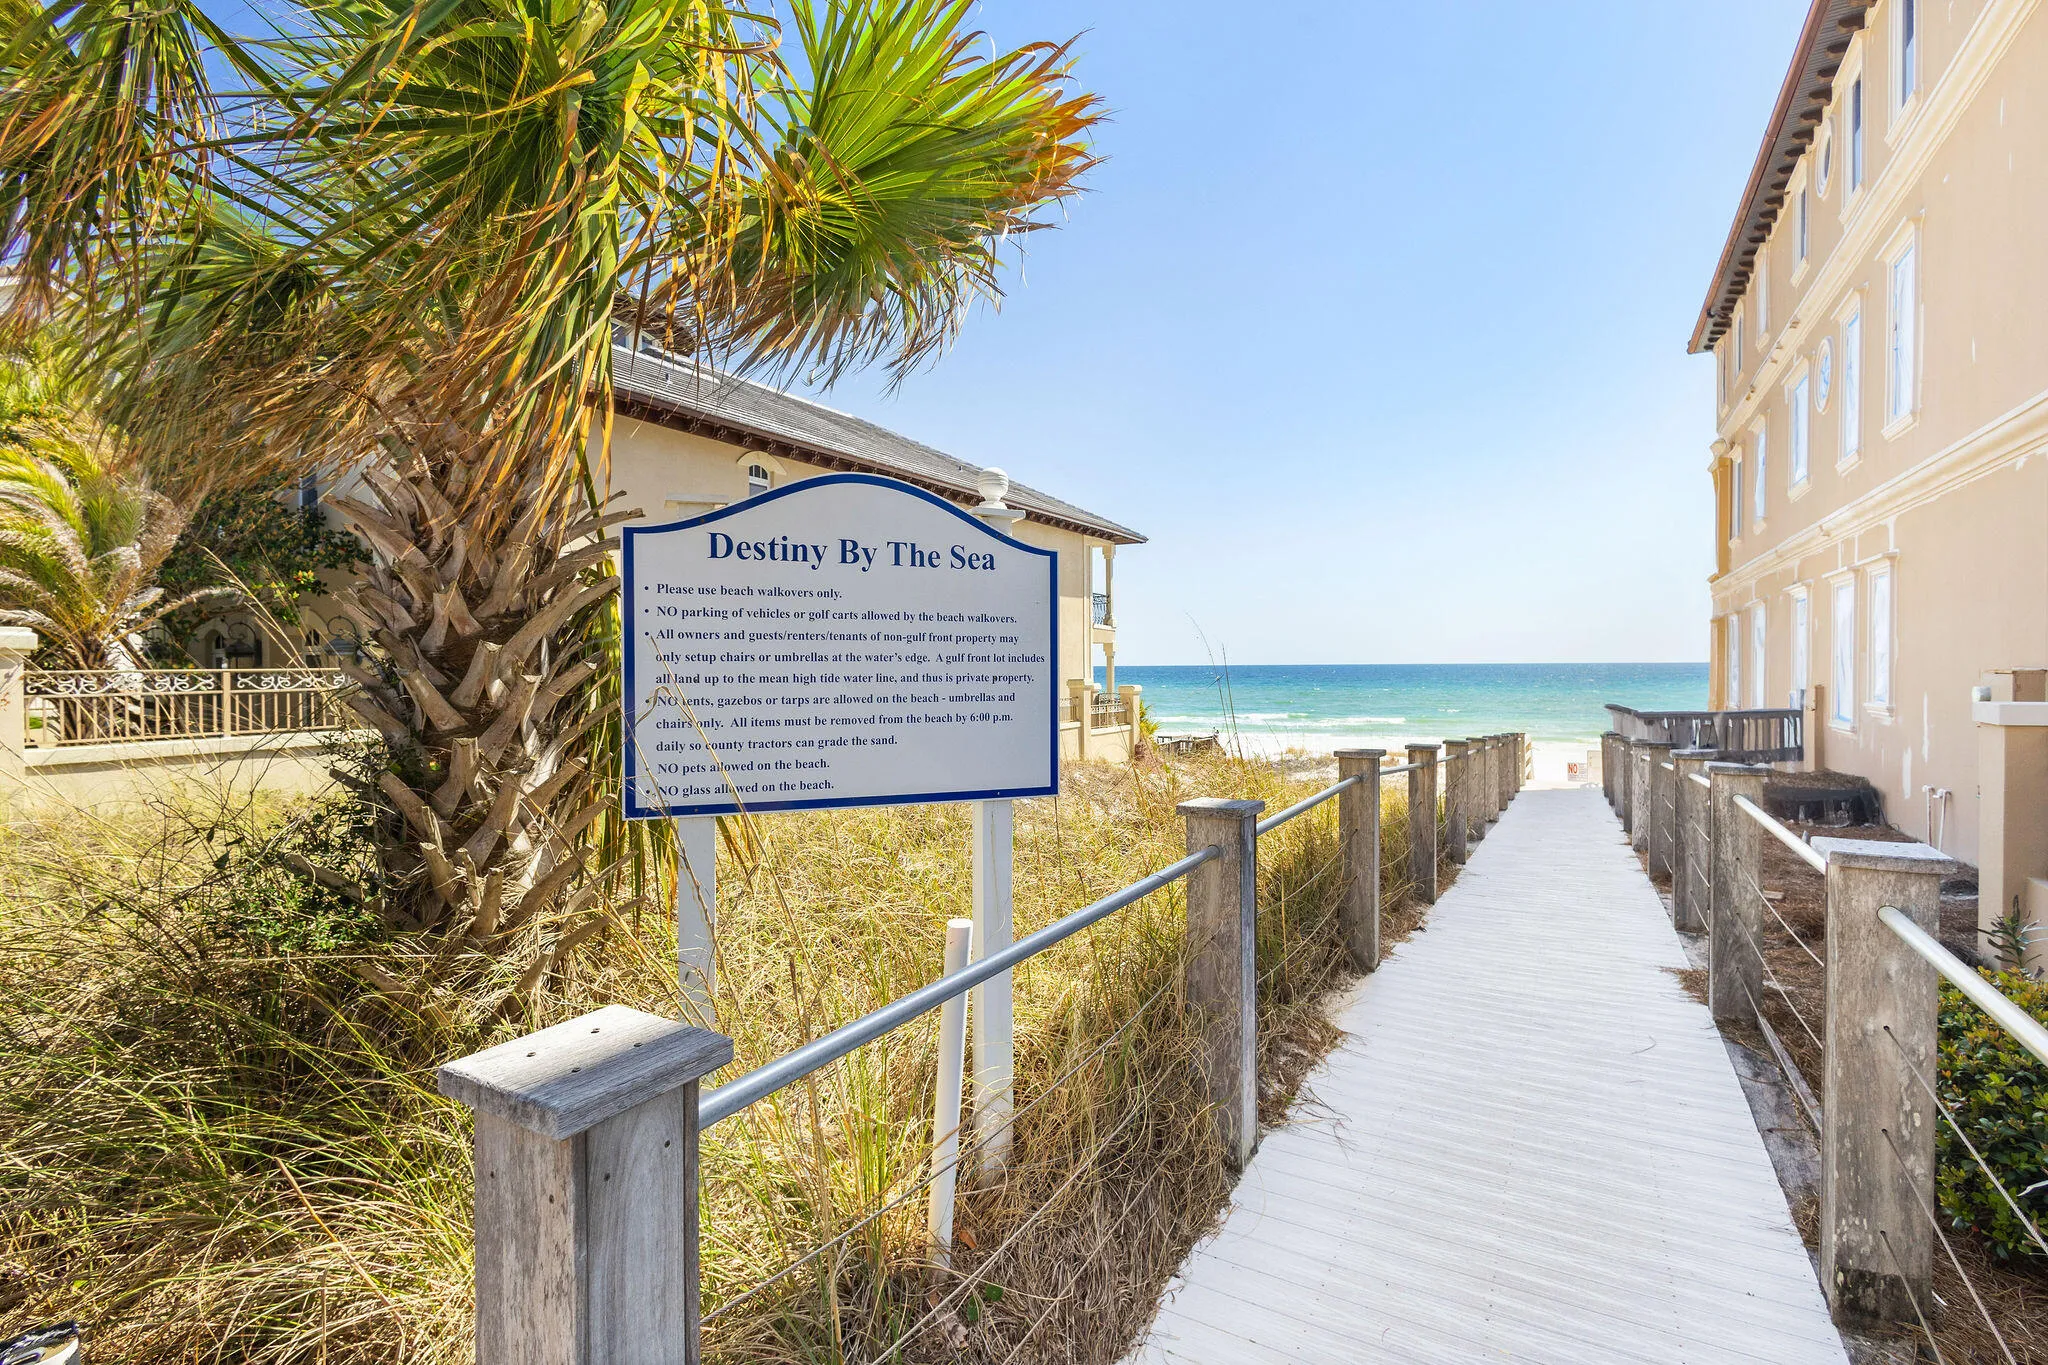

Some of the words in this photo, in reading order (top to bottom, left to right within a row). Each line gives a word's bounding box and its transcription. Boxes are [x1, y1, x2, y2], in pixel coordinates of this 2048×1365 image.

[707, 532, 828, 570] Destiny
[838, 539, 877, 572] By
[887, 541, 941, 568] The
[950, 545, 995, 570] Sea
[657, 584, 694, 594] Please
[721, 585, 753, 596] beach
[758, 587, 813, 597] walkovers
[817, 589, 842, 600] only.
[657, 606, 677, 616] NO
[682, 607, 728, 619] parking
[732, 608, 744, 617] of
[747, 608, 790, 619] vehicles
[794, 611, 805, 619] or
[809, 610, 830, 620] golf
[862, 611, 900, 620] allowed
[904, 612, 915, 623] by
[919, 612, 934, 621] the
[937, 613, 964, 622] beach
[968, 614, 1017, 623] walkovers.
[656, 629, 674, 639] All
[724, 630, 745, 639] and
[749, 630, 867, 642] guests/renters/tenants
[871, 632, 881, 641] of
[884, 633, 926, 644] non-gulf
[929, 633, 952, 642] front
[955, 634, 996, 645] property
[1000, 636, 1018, 645] may
[656, 652, 681, 664] only
[685, 653, 716, 664] setup
[720, 652, 755, 661] chairs
[775, 652, 828, 662] umbrellas
[846, 652, 861, 662] the
[905, 653, 930, 664] edge.
[936, 653, 942, 662] A
[946, 653, 964, 664] gulf
[967, 653, 990, 662] front
[993, 653, 1005, 663] lot
[1008, 653, 1045, 663] includes
[656, 674, 670, 683] all
[675, 674, 699, 683] land
[704, 676, 719, 686] up
[738, 674, 753, 683] the
[793, 674, 816, 685] high
[820, 674, 840, 683] tide
[876, 674, 897, 683] line,
[900, 674, 918, 682] and
[922, 673, 942, 682] thus
[946, 673, 953, 682] is
[956, 674, 989, 684] private
[992, 675, 1034, 684] property.
[658, 696, 678, 706] NO
[682, 697, 714, 707] tents,
[718, 696, 762, 708] gazebos
[766, 697, 778, 705] or
[781, 696, 808, 706] tarps
[834, 694, 873, 703] allowed
[892, 694, 907, 703] the
[911, 694, 939, 702] beach
[949, 693, 995, 702] umbrellas
[999, 693, 1015, 701] and
[656, 719, 692, 729] chairs
[697, 719, 724, 730] only.
[730, 718, 747, 727] All
[751, 718, 781, 727] items
[785, 718, 810, 726] must
[815, 716, 827, 725] be
[830, 715, 875, 725] removed
[879, 715, 903, 724] from
[907, 714, 922, 723] the
[925, 714, 953, 723] beach
[956, 713, 967, 724] by
[970, 713, 990, 722] 6:00
[993, 715, 1013, 723] p.m.
[656, 741, 685, 753] daily
[706, 740, 744, 751] county
[748, 739, 792, 748] tractors
[818, 737, 848, 748] grade
[852, 736, 867, 745] the
[871, 735, 897, 745] sand.
[658, 763, 678, 773] NO
[682, 763, 706, 775] pets
[710, 762, 753, 771] allowed
[758, 762, 770, 770] on
[774, 760, 792, 769] the
[795, 759, 829, 768] beach.
[1568, 762, 1578, 774] NO
[658, 785, 678, 796] NO
[683, 785, 710, 797] glass
[715, 783, 758, 793] allowed
[779, 782, 796, 791] the
[800, 780, 833, 789] beach.
